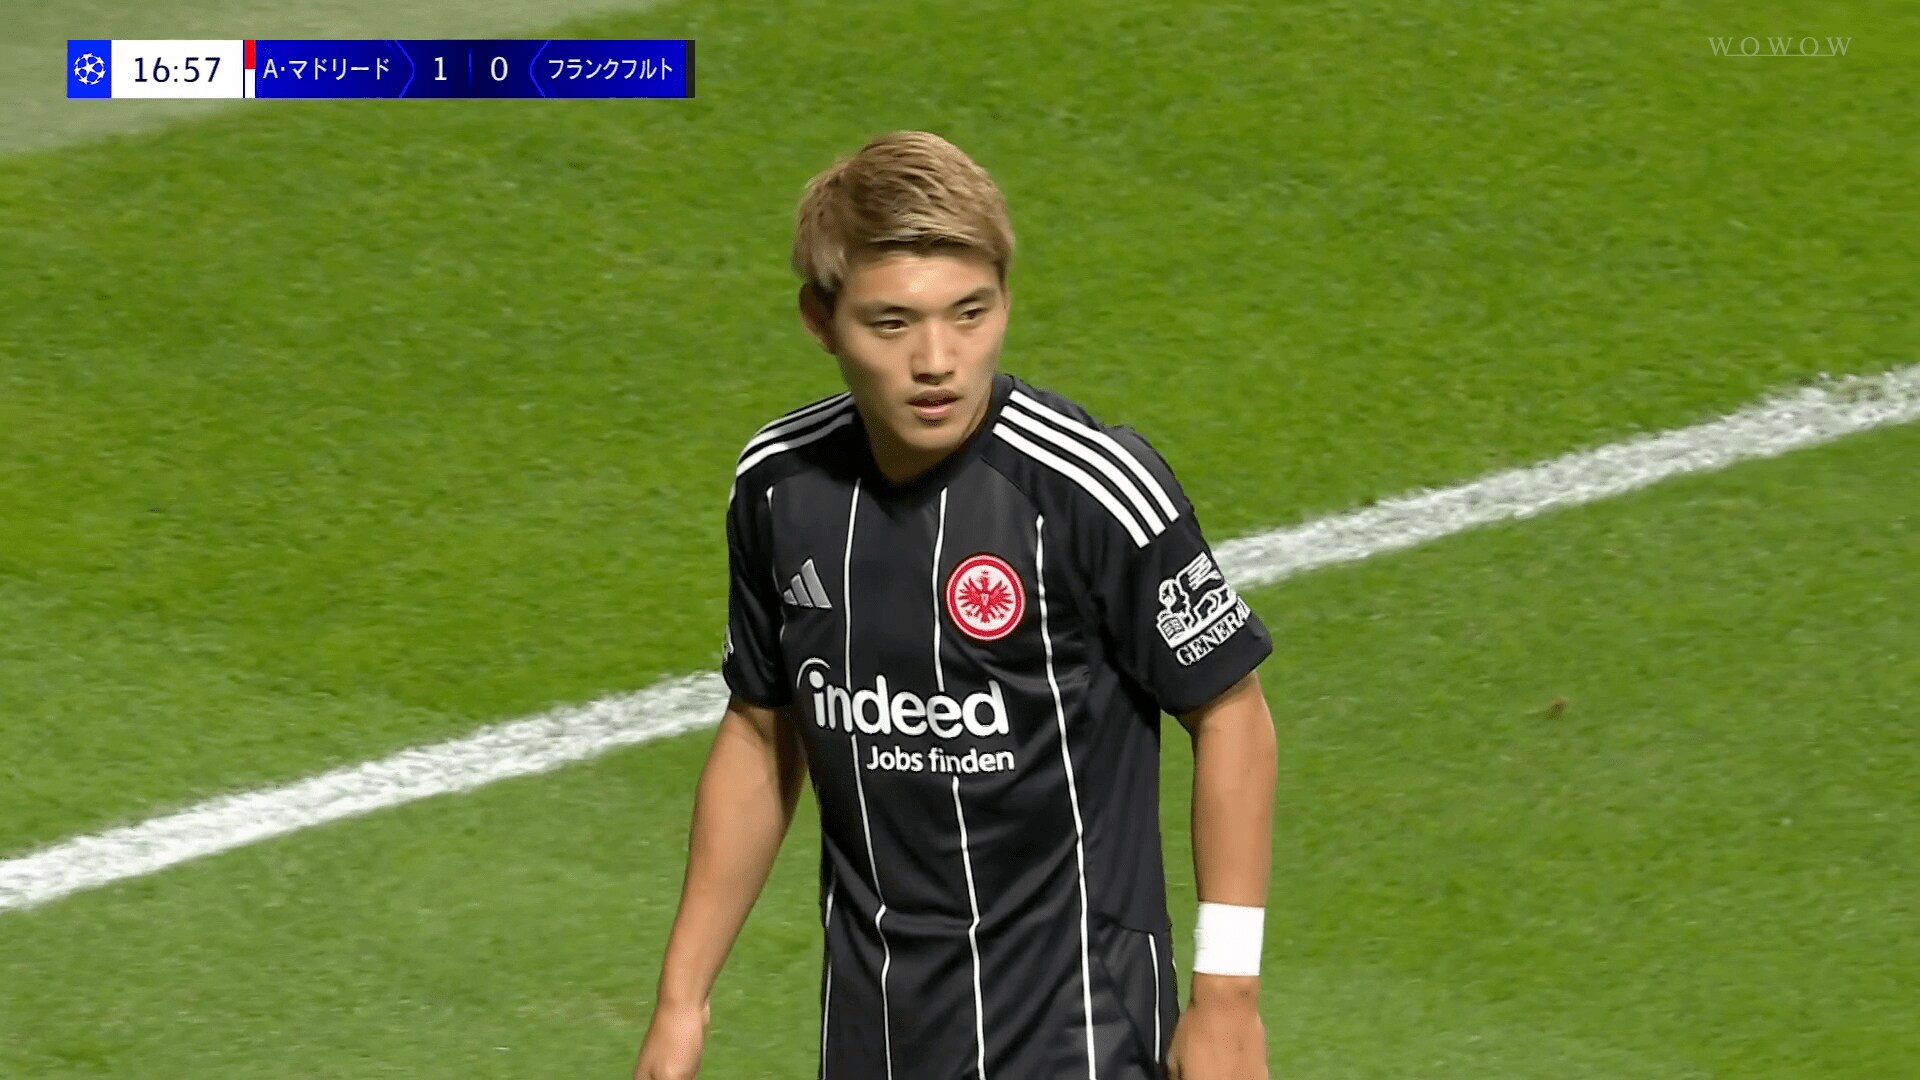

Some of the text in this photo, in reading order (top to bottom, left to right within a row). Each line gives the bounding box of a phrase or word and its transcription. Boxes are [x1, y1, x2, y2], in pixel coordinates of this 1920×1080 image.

[807, 668, 1010, 739] indeed
[866, 745, 1016, 774] Jobs finden
